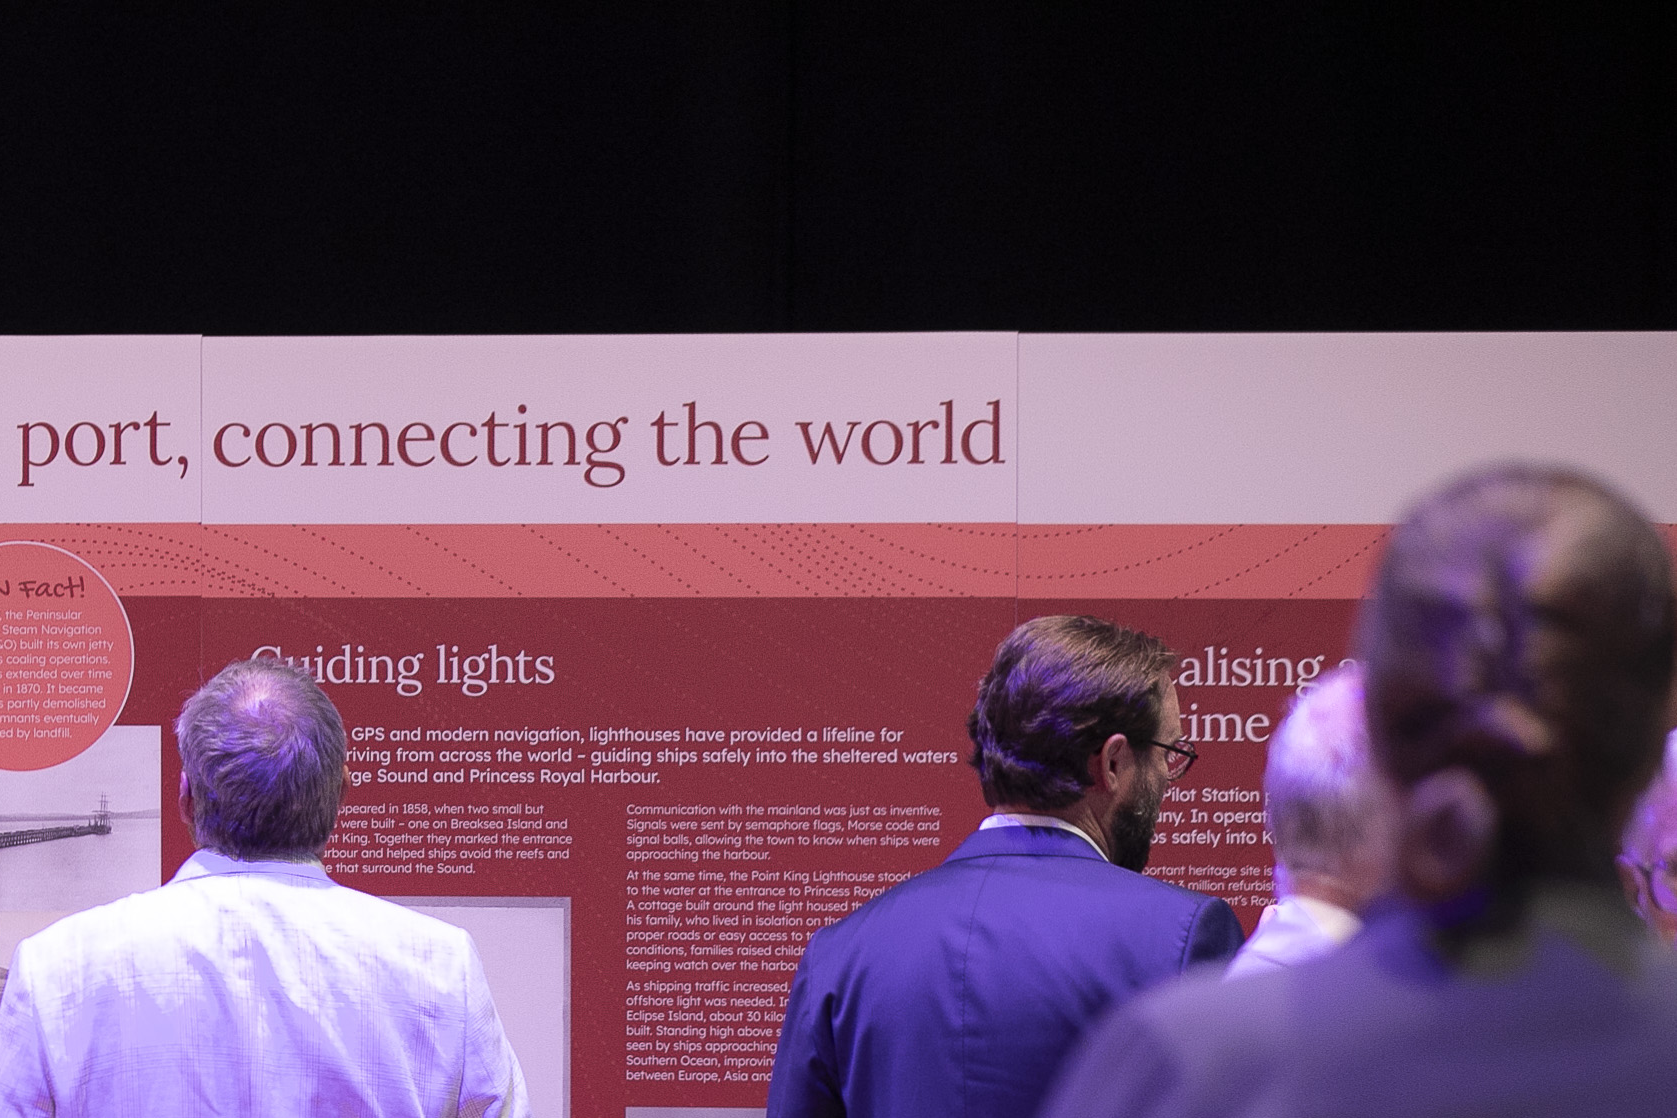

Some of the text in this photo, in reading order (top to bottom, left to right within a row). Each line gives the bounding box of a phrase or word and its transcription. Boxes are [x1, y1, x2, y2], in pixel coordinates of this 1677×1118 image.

[17, 410, 190, 488] port,
[212, 403, 629, 488] connecting
[649, 400, 771, 467] the
[795, 399, 1006, 467] world
[18, 576, 85, 598] Fact!
[4, 609, 23, 621] the
[26, 609, 82, 621] Peninsular
[1, 624, 37, 635] Steam
[40, 624, 101, 638] Navigation
[436, 644, 556, 697] lights
[350, 726, 904, 747] GPS and modern navigation, lighthouses have provided a lifeline for
[344, 747, 390, 767] riving
[395, 747, 434, 763] from
[438, 751, 492, 763] across
[495, 747, 522, 763] the
[526, 747, 572, 763] world
[590, 747, 651, 768] guiding
[656, 748, 698, 768] ships
[702, 748, 751, 768] safely
[755, 748, 787, 764] into
[790, 748, 818, 764] the
[822, 748, 898, 764] sheltered
[902, 748, 958, 764] waters
[376, 767, 428, 783] Sound
[432, 767, 464, 783] and
[469, 768, 535, 784] Princess
[540, 768, 585, 788] Royal
[590, 768, 660, 784] Harbour.
[1201, 786, 1260, 802] Station
[625, 803, 942, 819] Communication with the mainland was just as inventive.
[1171, 829, 1257, 848] safely into
[1188, 864, 1273, 878] heritage site is
